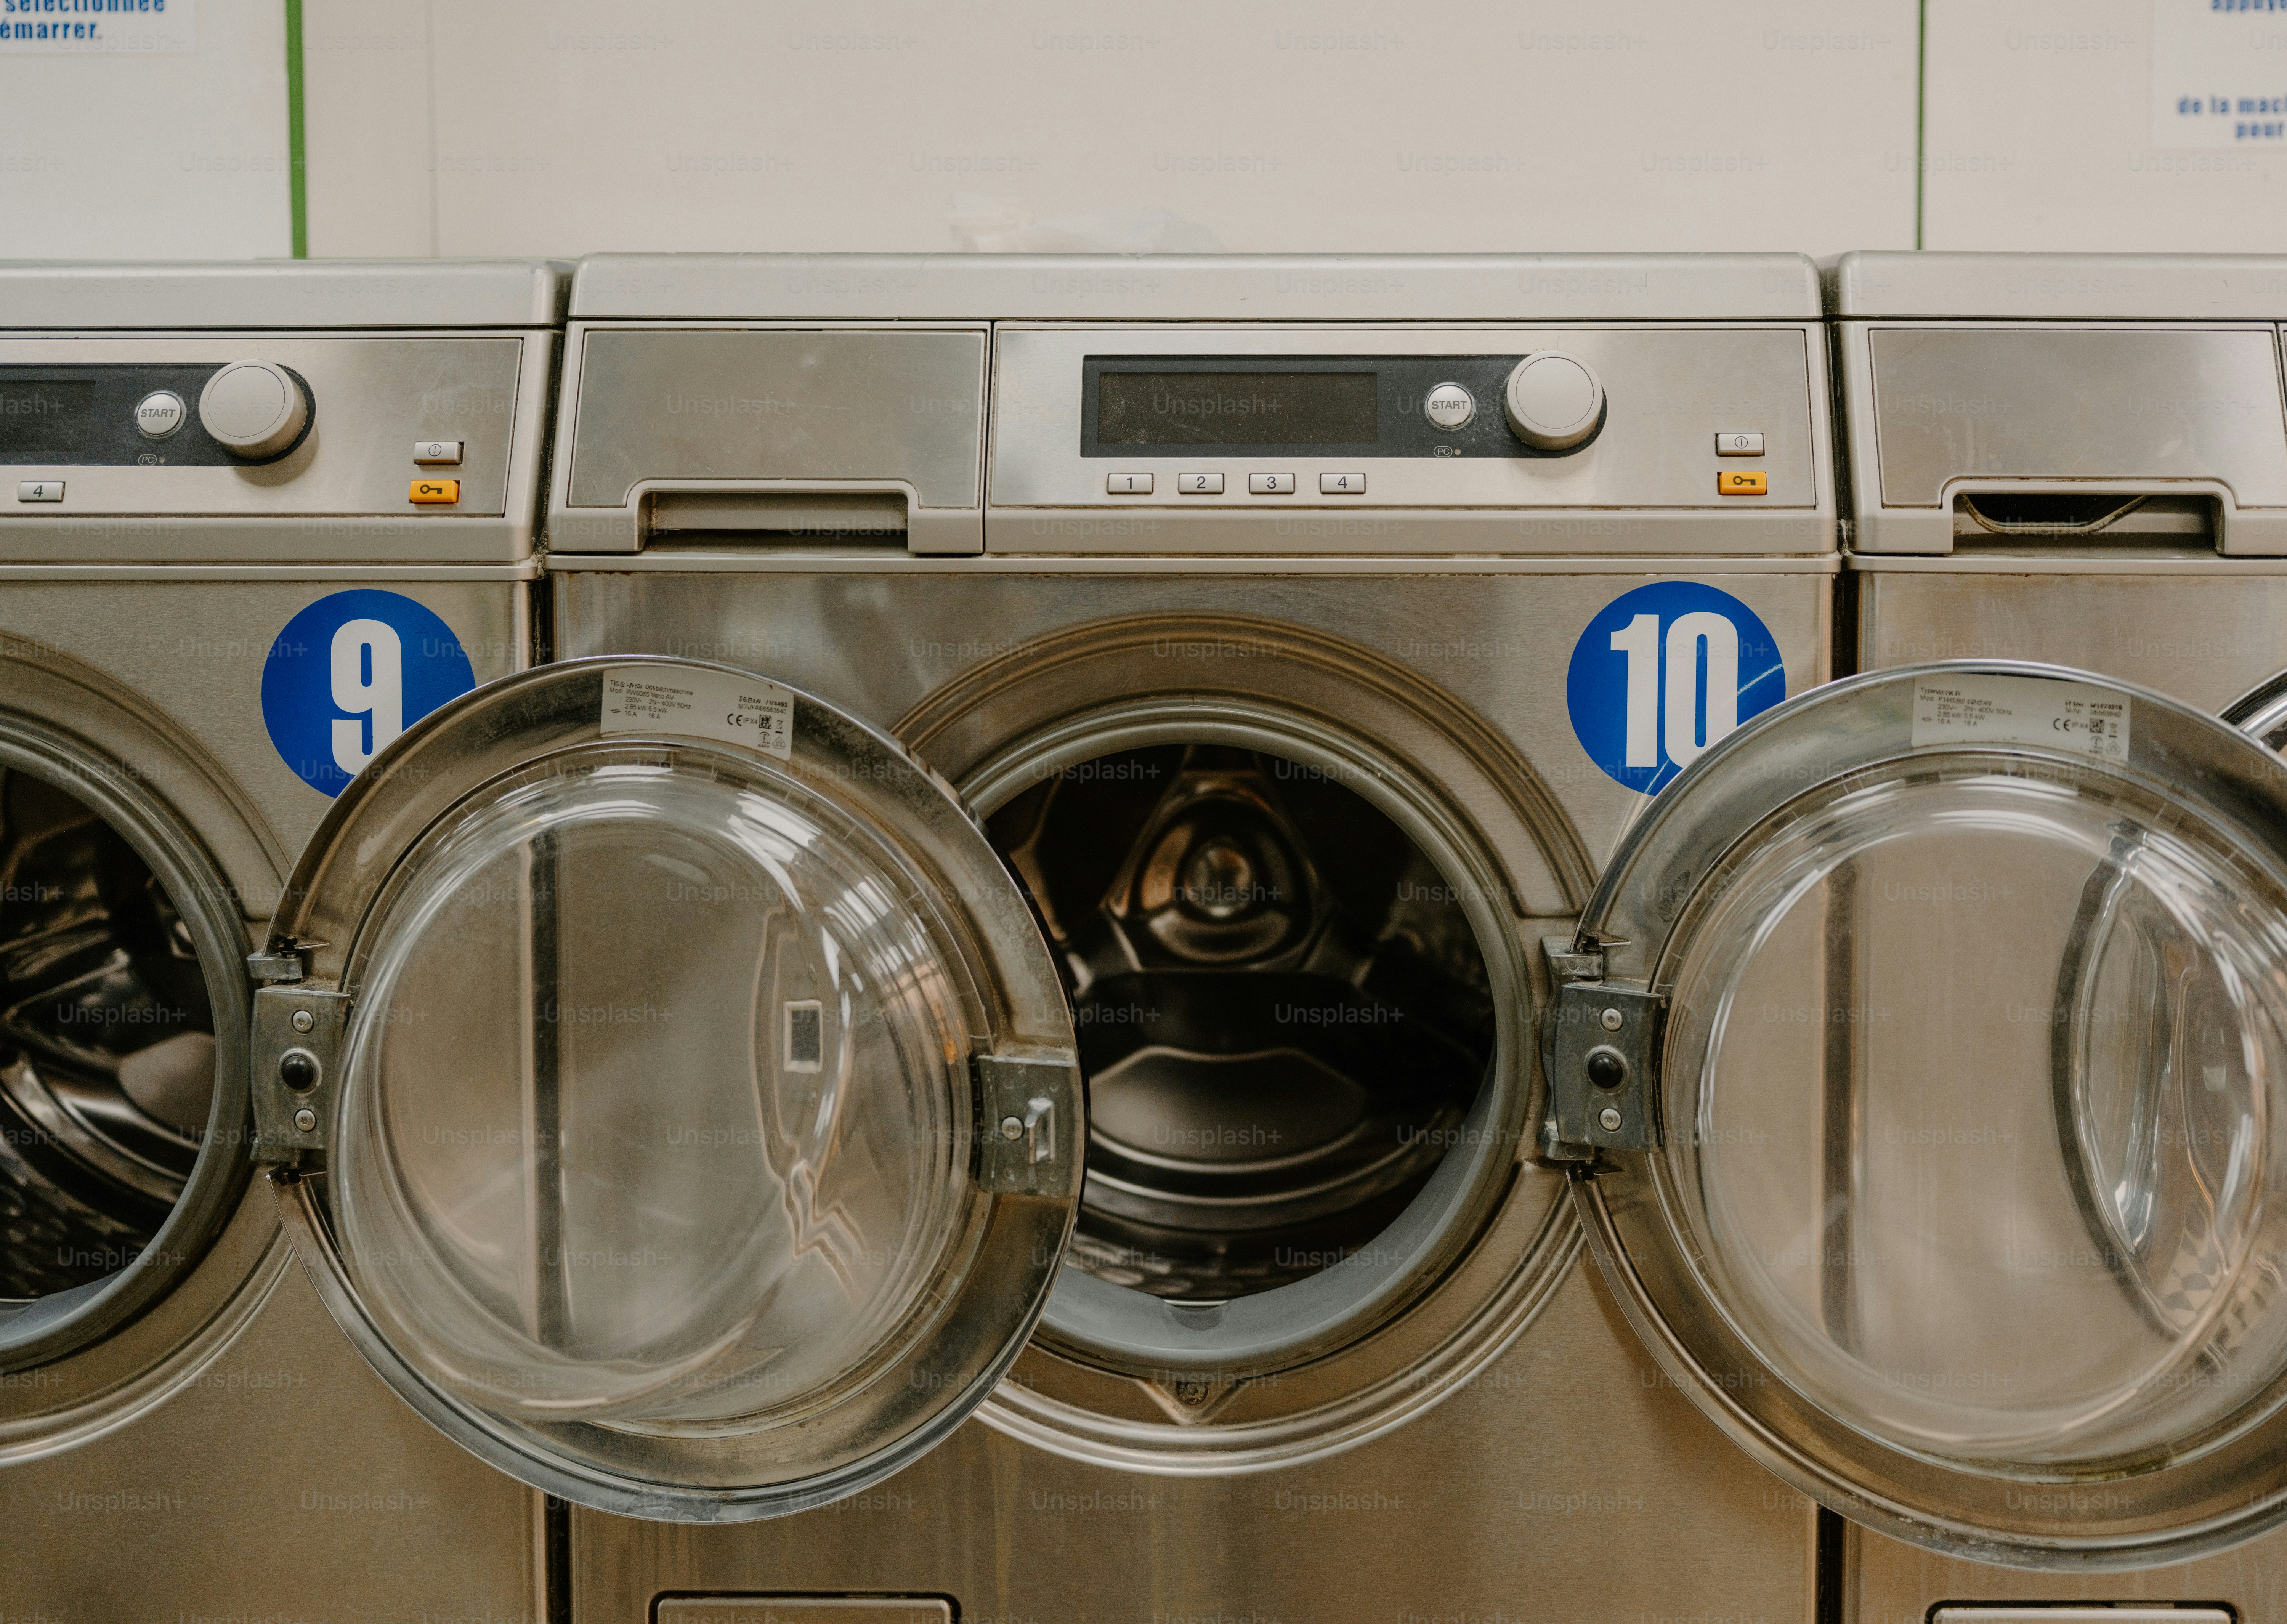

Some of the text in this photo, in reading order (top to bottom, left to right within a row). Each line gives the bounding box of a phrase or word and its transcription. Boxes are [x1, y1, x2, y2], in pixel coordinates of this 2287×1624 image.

[2238, 98, 2287, 114] mac
[1432, 401, 1467, 409] START
[141, 409, 176, 417] START
[1127, 476, 1132, 489] 1
[1197, 476, 1206, 489] 2
[1267, 476, 1276, 489] 3
[1338, 476, 1347, 489] 4
[33, 485, 43, 497] 4
[1610, 612, 1738, 768] 10
[331, 619, 402, 776] 9
